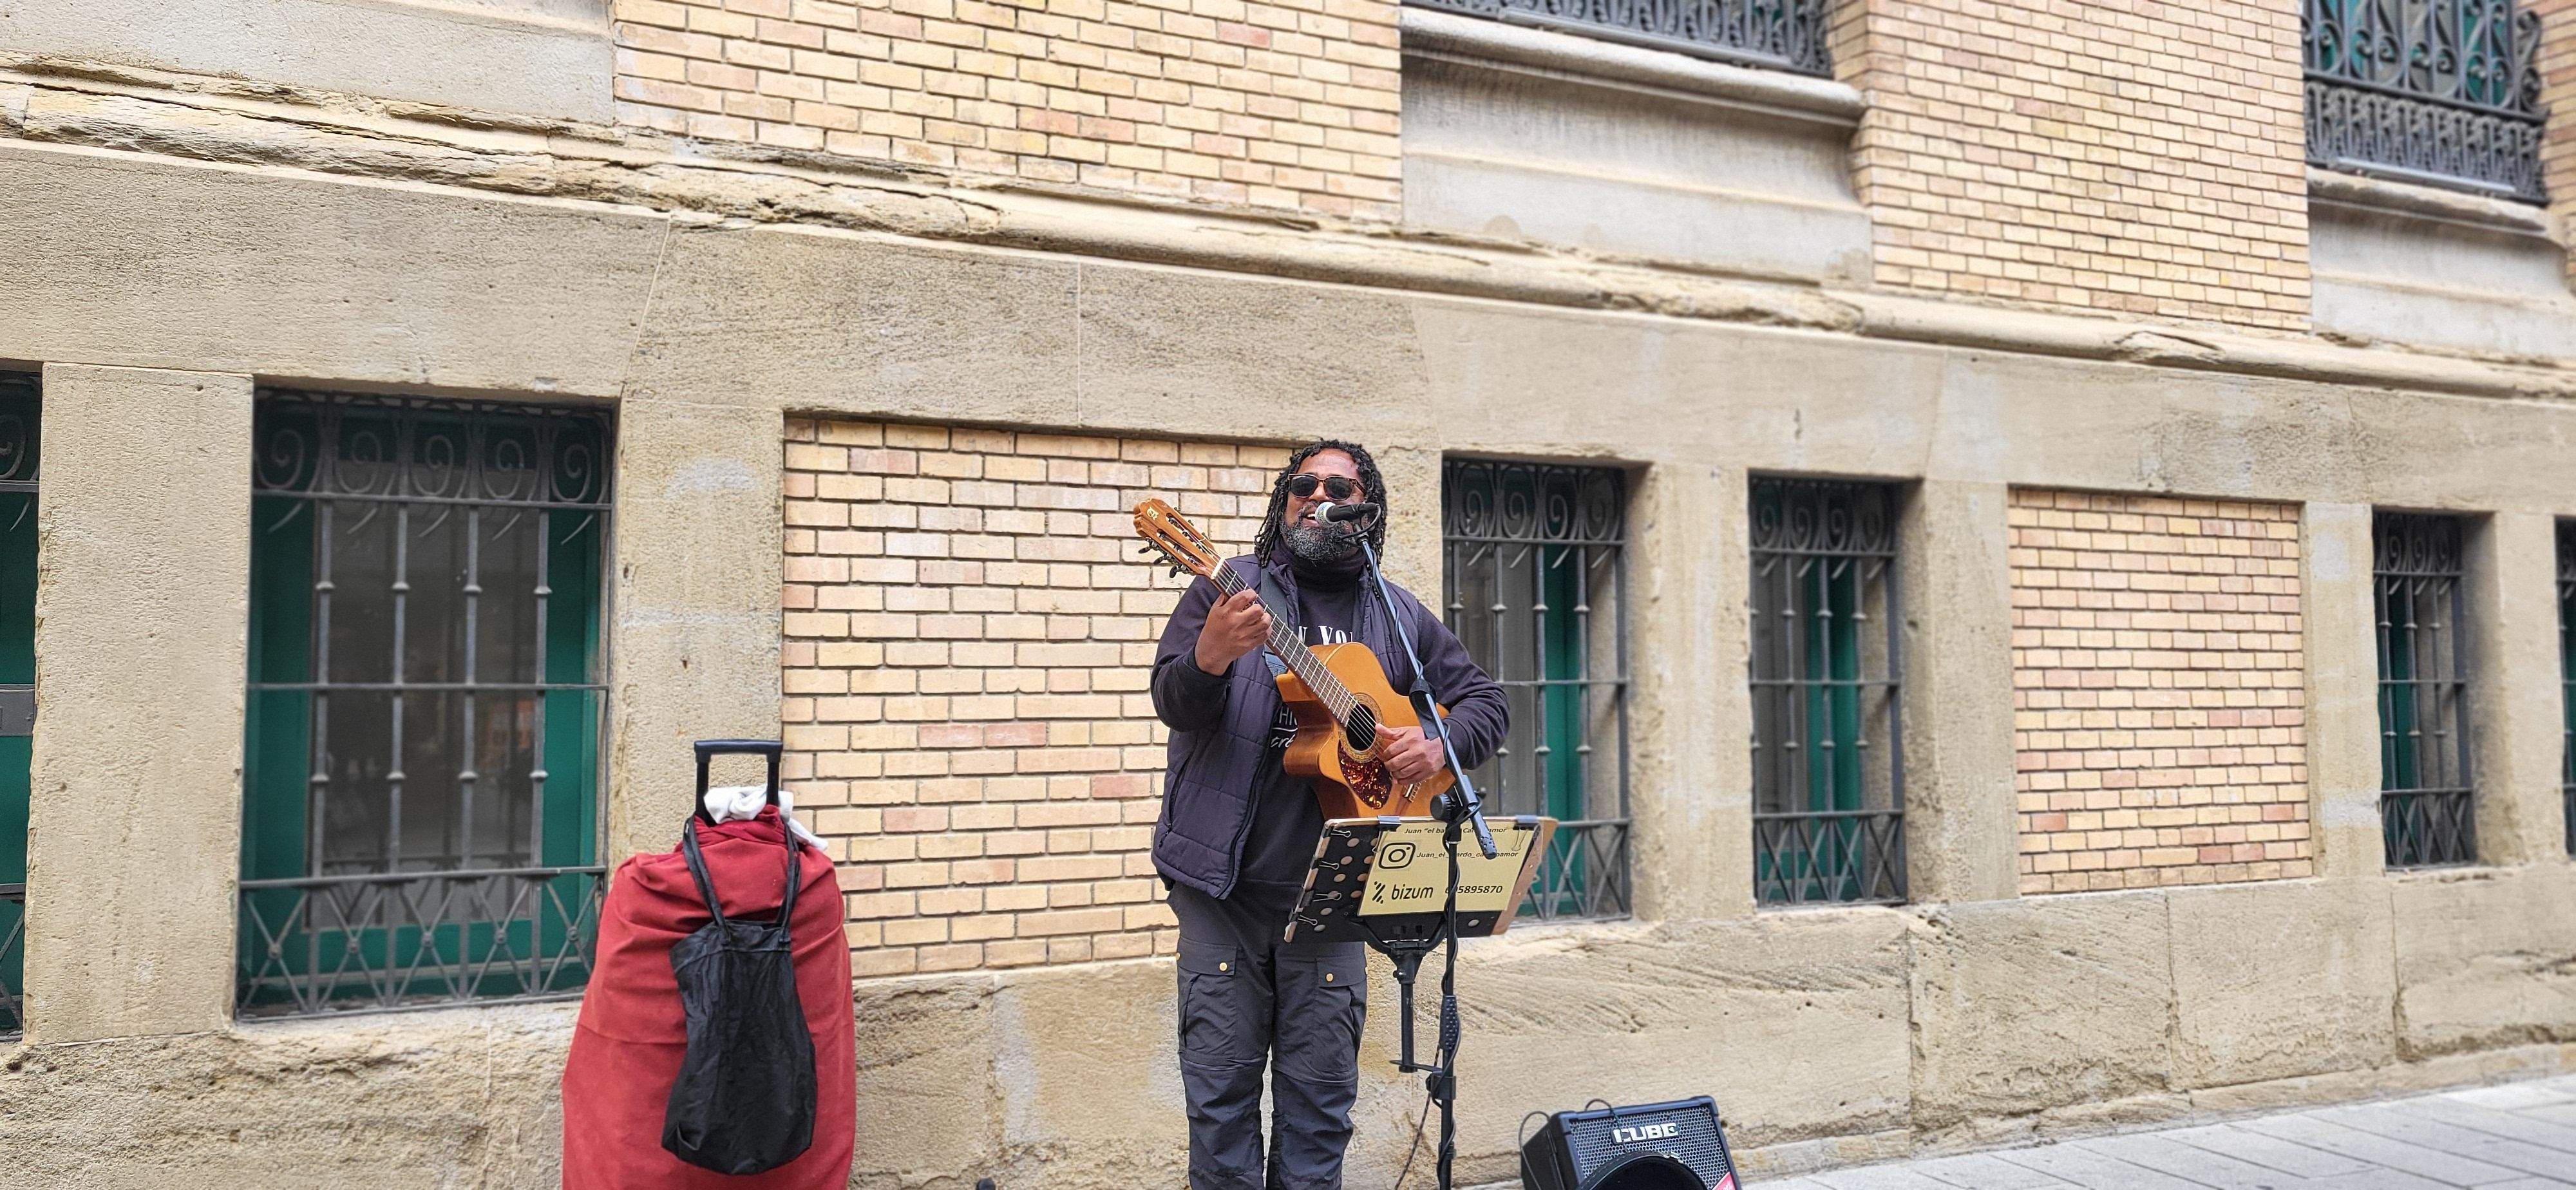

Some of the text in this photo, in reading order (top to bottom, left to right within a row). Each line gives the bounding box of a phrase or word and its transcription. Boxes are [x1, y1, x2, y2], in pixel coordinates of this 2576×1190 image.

[1391, 883, 1434, 900] bizum
[1444, 885, 1503, 894] 65895870
[1613, 1122, 1679, 1143] CUBE
